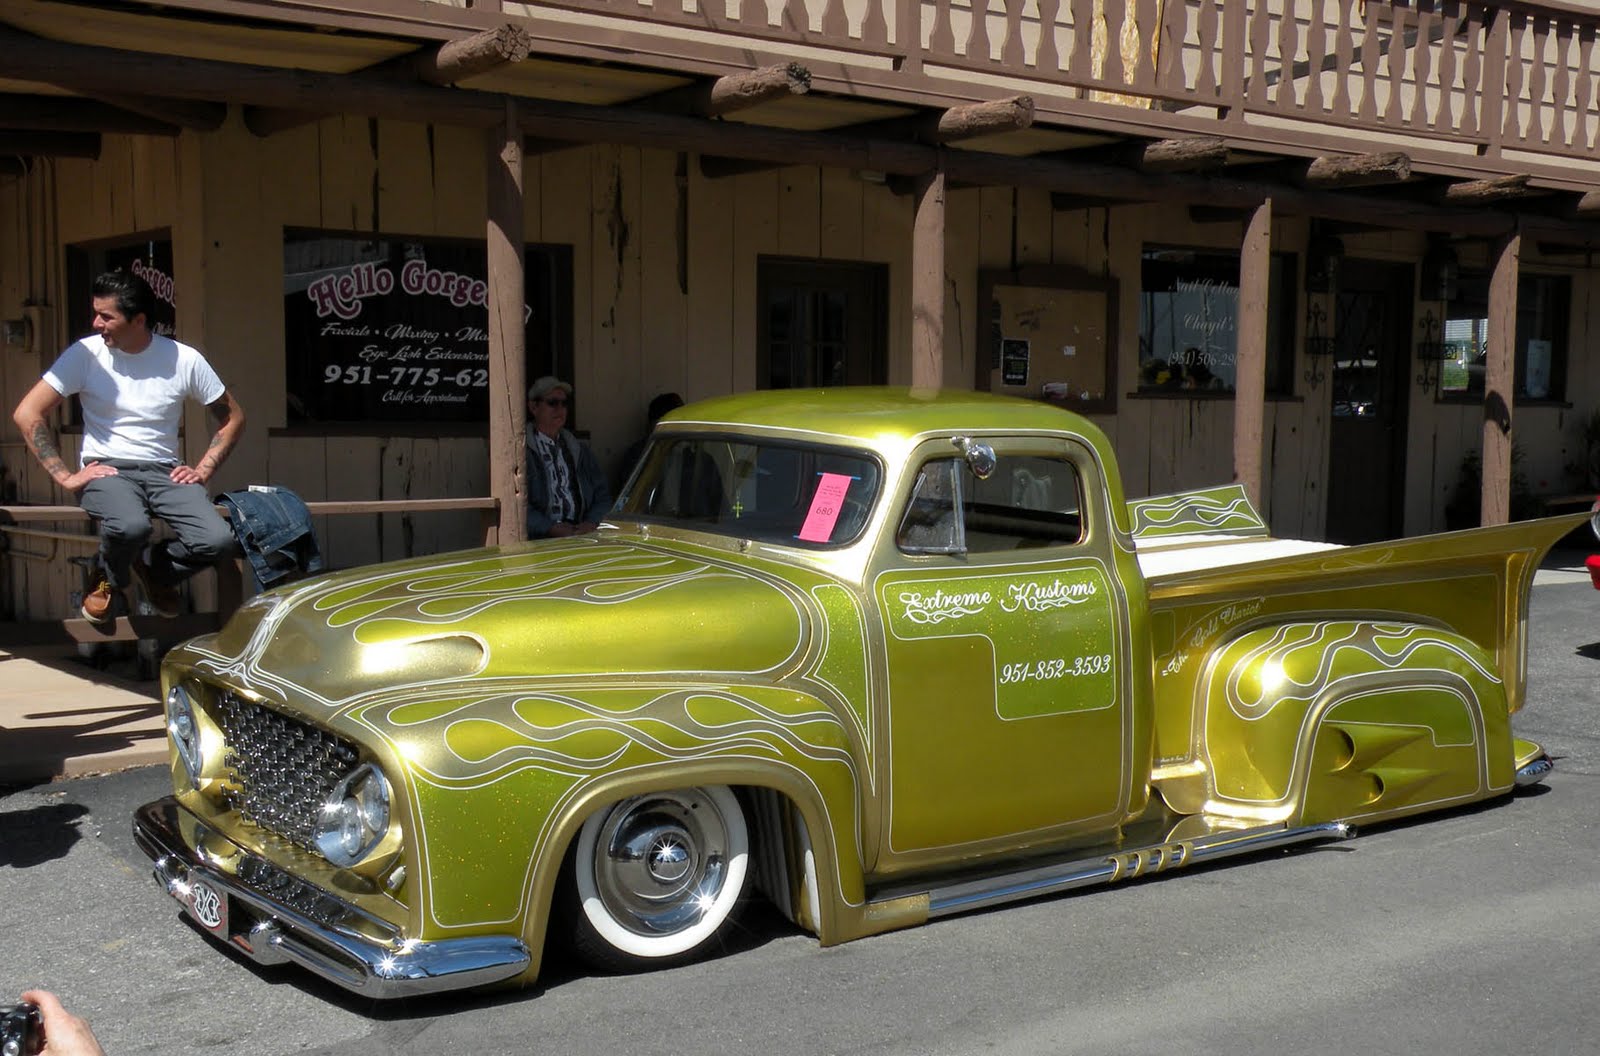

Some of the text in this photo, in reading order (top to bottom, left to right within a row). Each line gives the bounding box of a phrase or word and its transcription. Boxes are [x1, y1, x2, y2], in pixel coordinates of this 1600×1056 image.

[131, 258, 176, 308] Gorgeo
[308, 262, 394, 320] Hello
[1202, 278, 1240, 300] Cottag
[320, 322, 370, 337] Facials
[384, 324, 439, 344] Waxing
[359, 345, 389, 362] Eye
[387, 345, 422, 362] Lash
[1168, 352, 1195, 367] (951)
[324, 364, 488, 387] 951-775-62
[414, 389, 469, 404] Appointment
[816, 507, 833, 516] 680
[900, 579, 1097, 624] Extreme Kustoms
[1000, 654, 1112, 684] 951-852-3593
